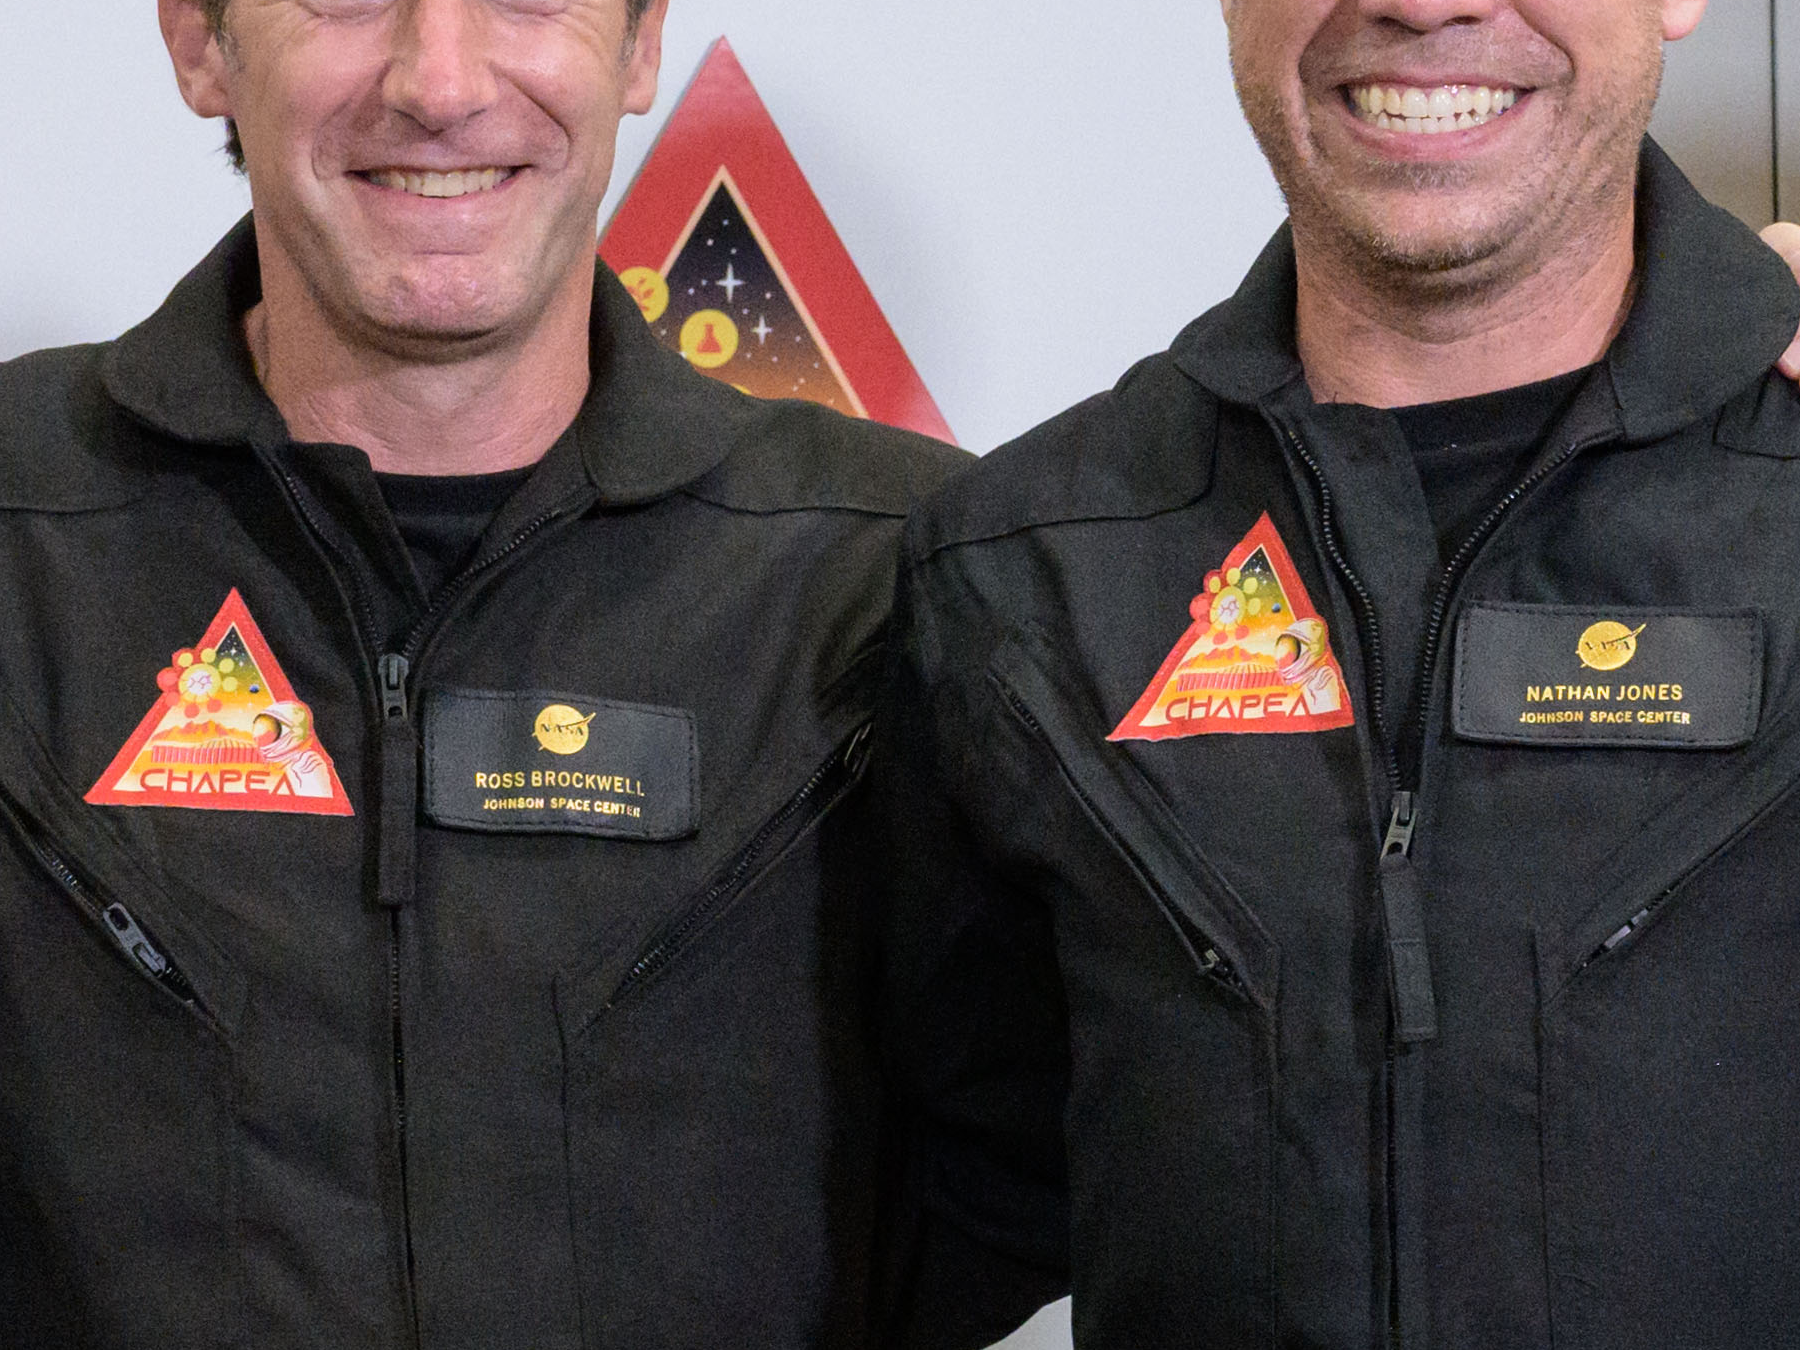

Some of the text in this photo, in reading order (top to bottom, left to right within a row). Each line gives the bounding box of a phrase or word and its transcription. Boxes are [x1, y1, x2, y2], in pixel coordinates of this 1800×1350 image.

[1527, 684, 1683, 701] NATHAN JONES
[1165, 692, 1310, 722] CHAPEA
[1519, 710, 1691, 725] JOHNSON SPACE CENTER
[139, 768, 296, 796] CHAPEA
[475, 770, 645, 796] ROSS BROCKWELL
[483, 798, 641, 818] JOHNSON SPACE CENTER
